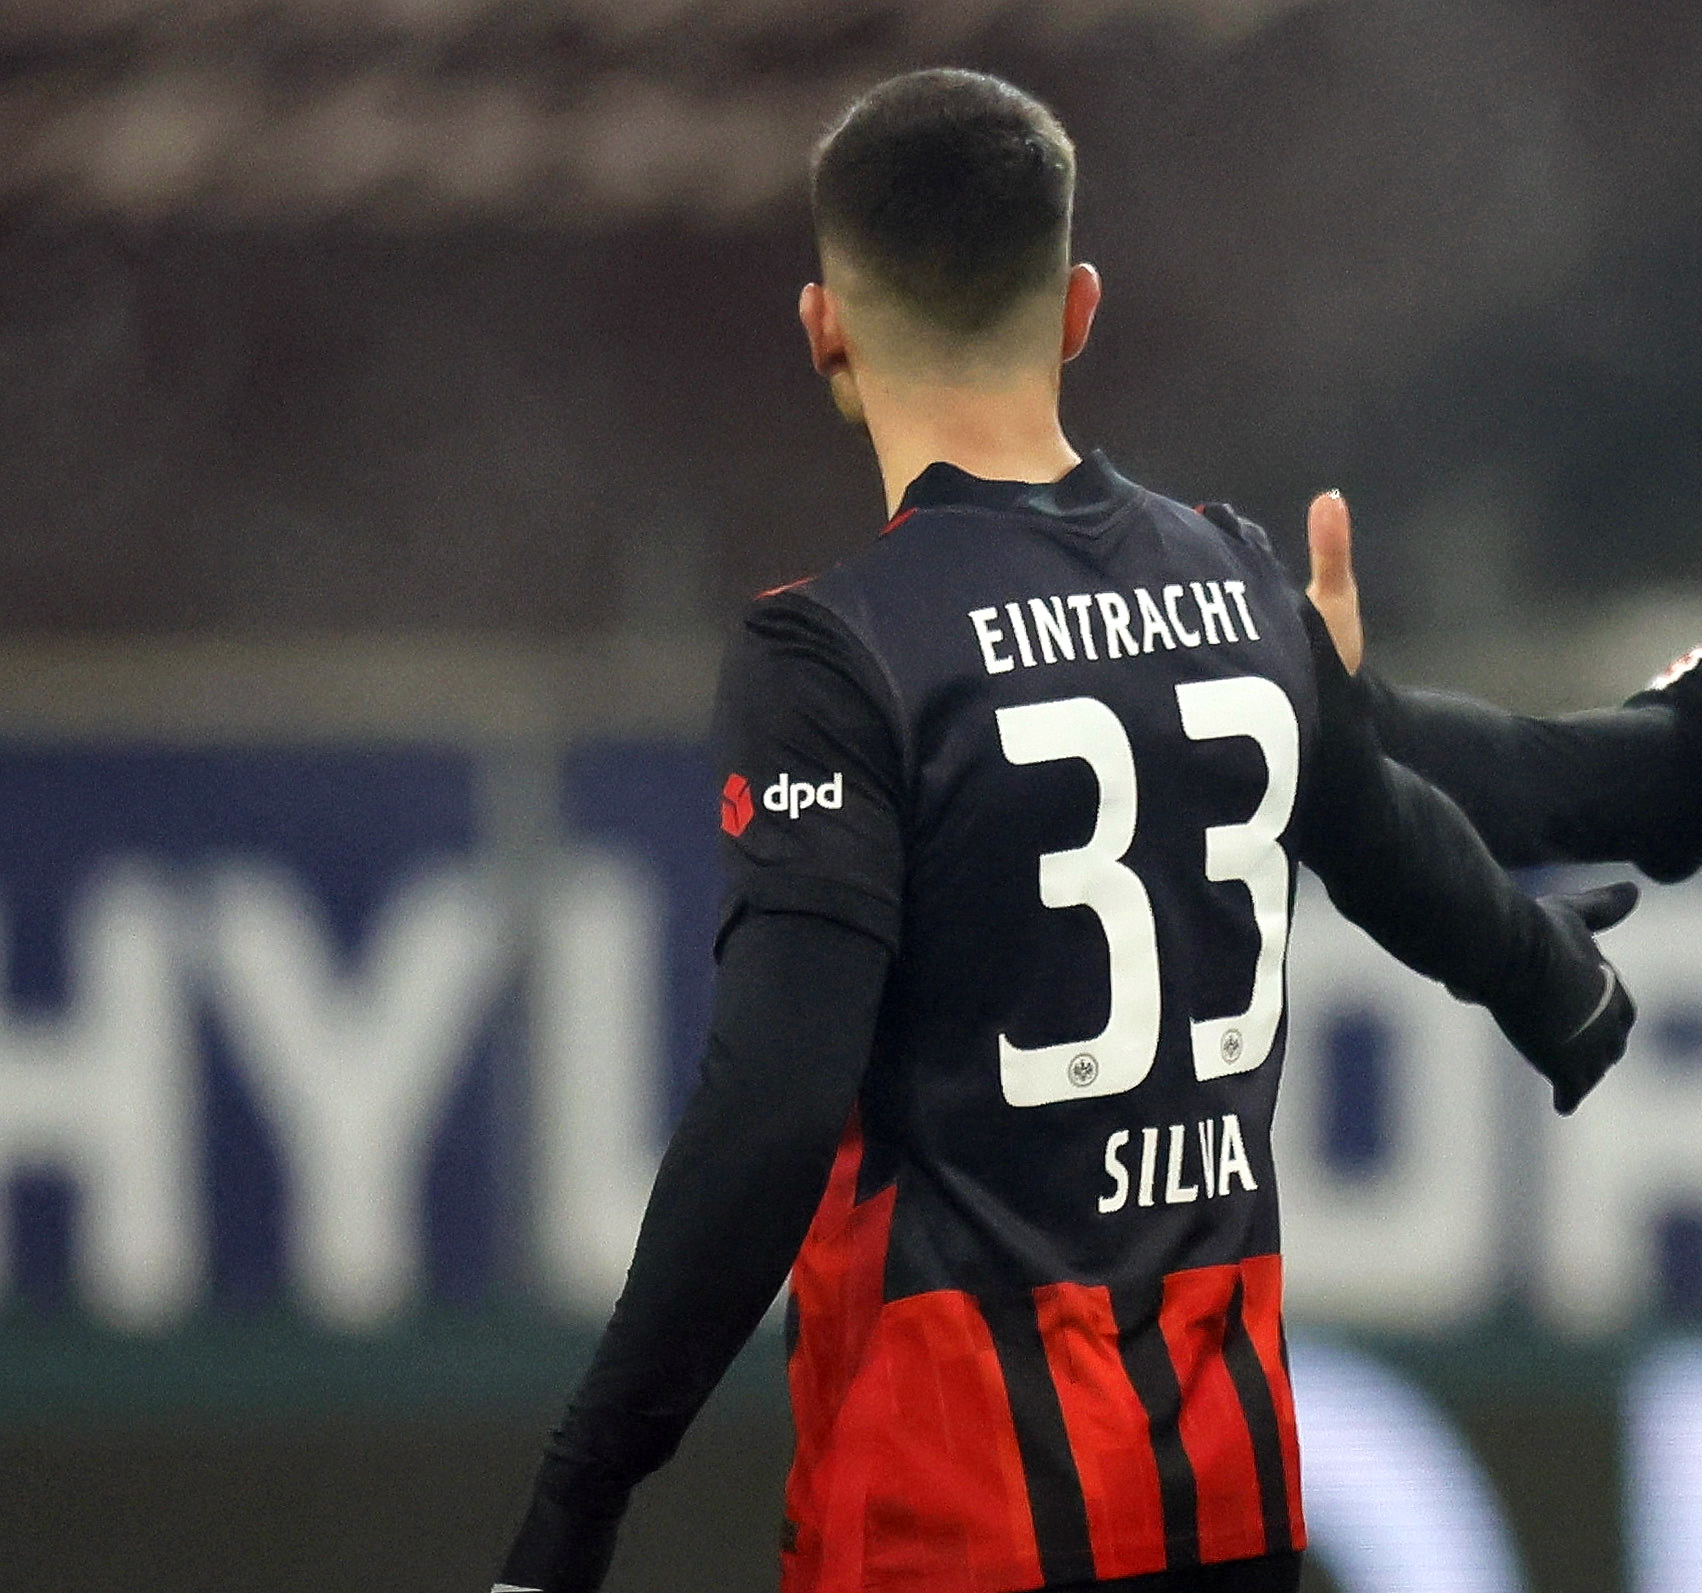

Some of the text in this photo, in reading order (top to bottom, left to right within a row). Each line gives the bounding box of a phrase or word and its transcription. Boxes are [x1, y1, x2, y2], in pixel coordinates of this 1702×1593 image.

[967, 579, 1261, 675] EINTRACHT
[762, 771, 843, 819] dpd
[994, 675, 1300, 1108] 33
[1098, 1114, 1259, 1213] SILVA
